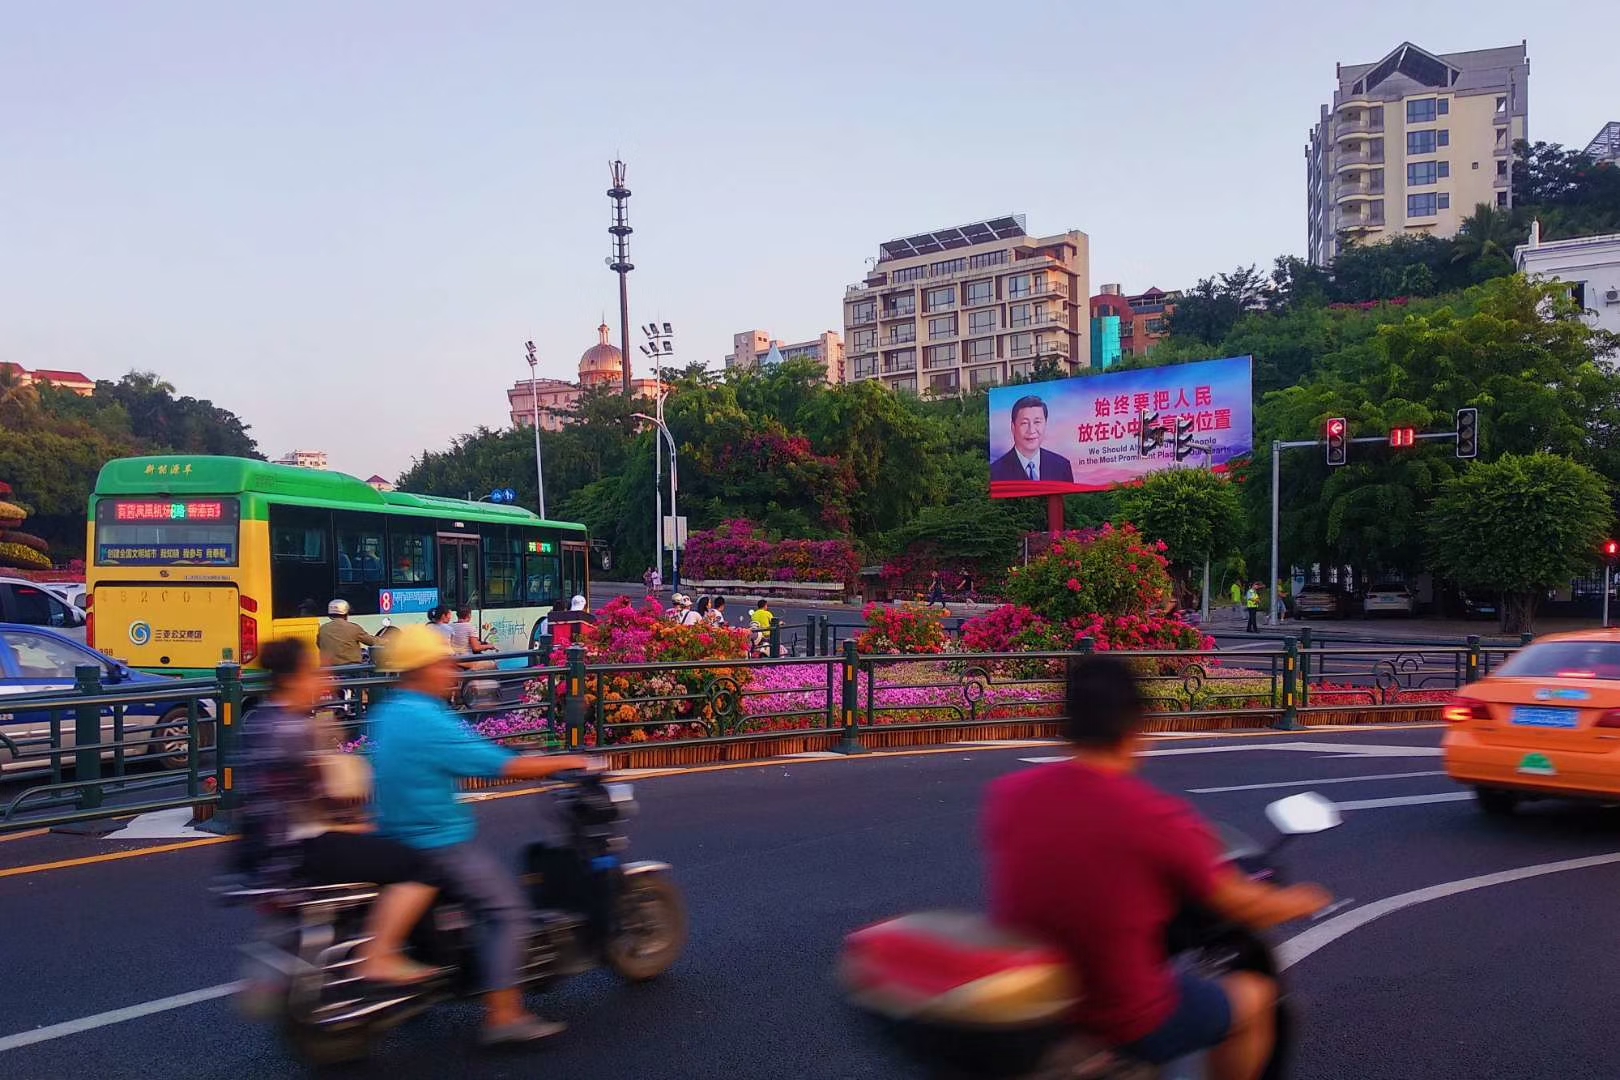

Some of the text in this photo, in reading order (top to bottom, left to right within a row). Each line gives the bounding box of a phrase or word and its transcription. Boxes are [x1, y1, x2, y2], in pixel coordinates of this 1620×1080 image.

[1095, 385, 1212, 418] 始终要把人民
[1078, 408, 1232, 443] 放在心中高的位置
[1089, 447, 1100, 455] We
[1102, 444, 1128, 454] Should
[1087, 457, 1099, 465] the
[1100, 455, 1117, 464] Most
[1158, 450, 1177, 459] Plac
[144, 463, 193, 477] 新能源车
[382, 592, 391, 611] 8
[155, 629, 203, 639] 三亚公交集团
